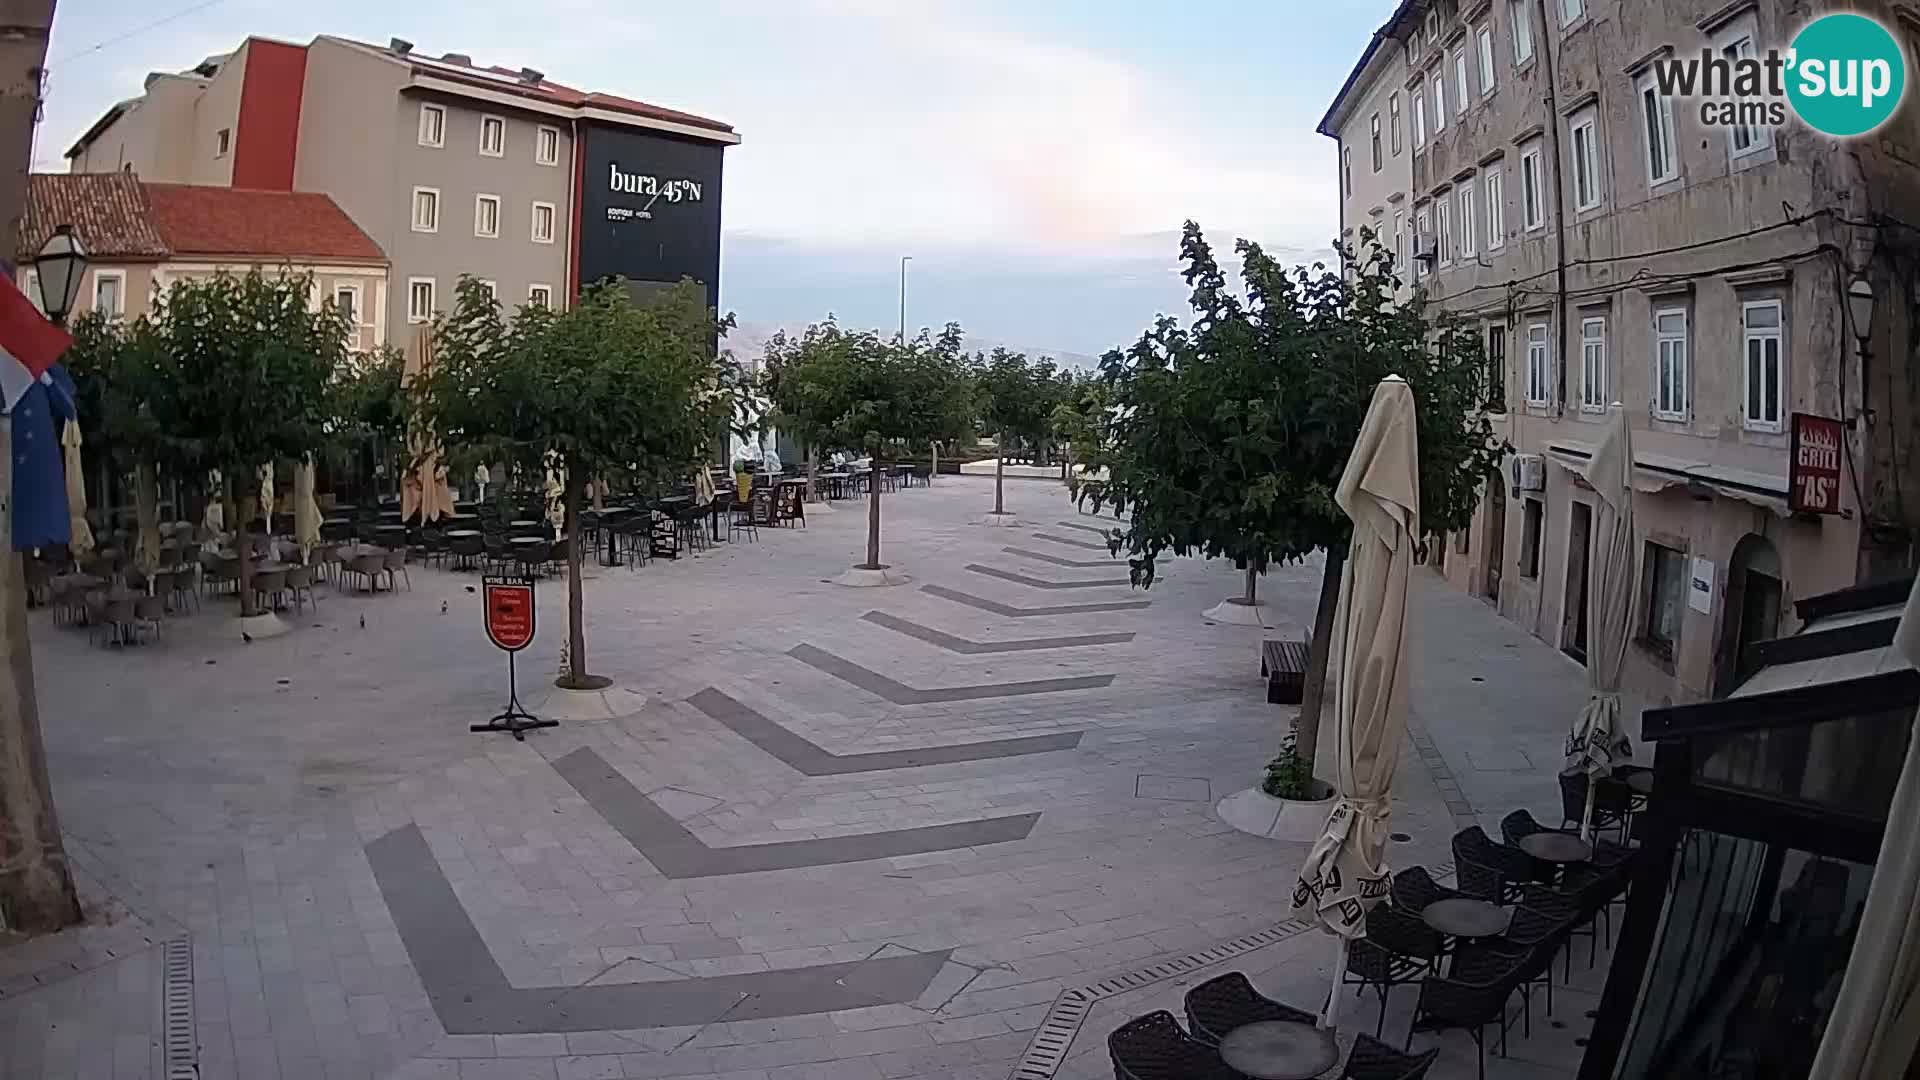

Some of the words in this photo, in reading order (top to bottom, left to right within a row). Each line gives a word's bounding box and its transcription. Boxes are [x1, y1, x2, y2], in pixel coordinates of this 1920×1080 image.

[610, 164, 657, 196] bura
[1798, 447, 1838, 471] GRILL
[484, 577, 504, 585] WINE
[506, 577, 523, 585] BAR
